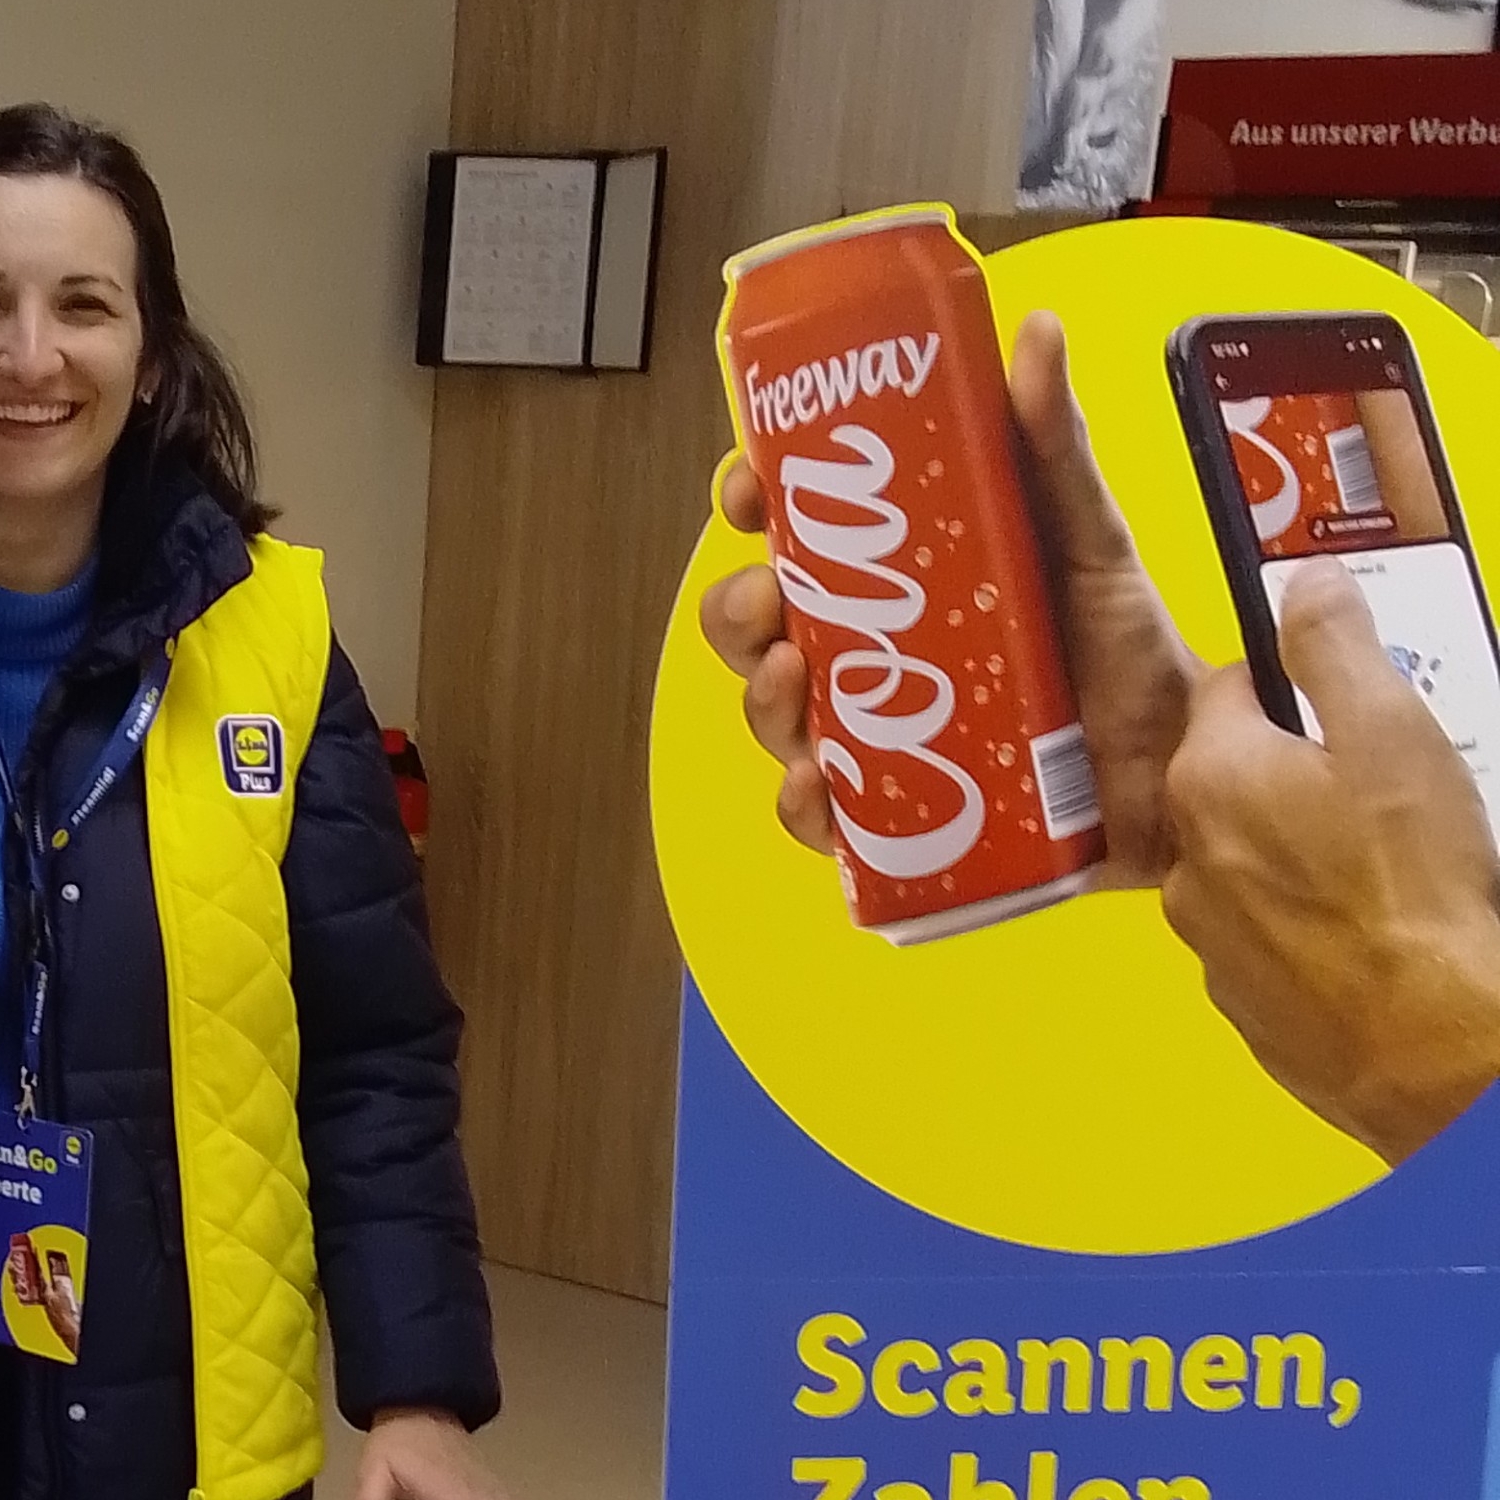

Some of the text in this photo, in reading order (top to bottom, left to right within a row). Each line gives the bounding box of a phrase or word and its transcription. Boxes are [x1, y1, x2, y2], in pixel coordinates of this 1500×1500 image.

[1229, 117, 1500, 147] Aus unserer Werbu
[745, 331, 941, 438] Freeway
[773, 423, 986, 880] Cola
[239, 772, 272, 791] Plus
[792, 1312, 1362, 1428] Scannen,
